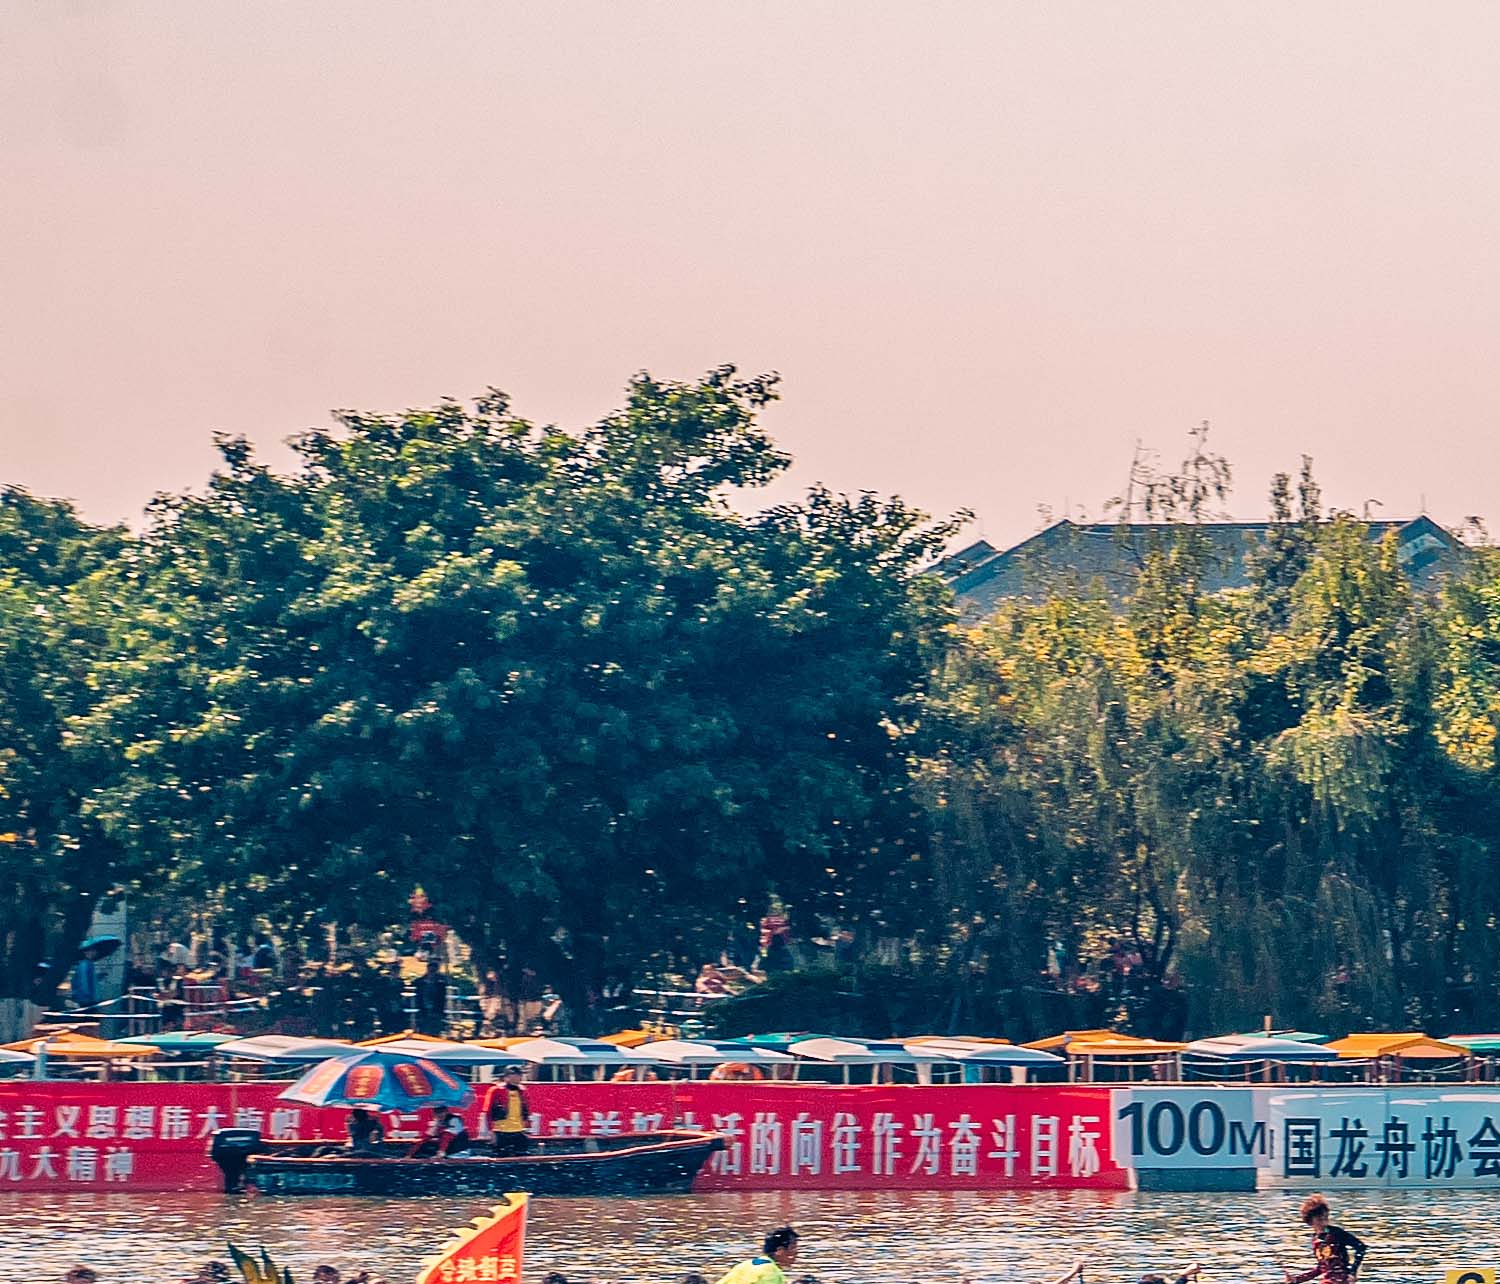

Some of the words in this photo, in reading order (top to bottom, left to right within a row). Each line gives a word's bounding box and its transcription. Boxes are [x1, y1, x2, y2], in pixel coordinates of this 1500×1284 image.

[0, 1105, 299, 1140] 主义思想伟大旗帜
[1117, 1100, 1266, 1157] 100M
